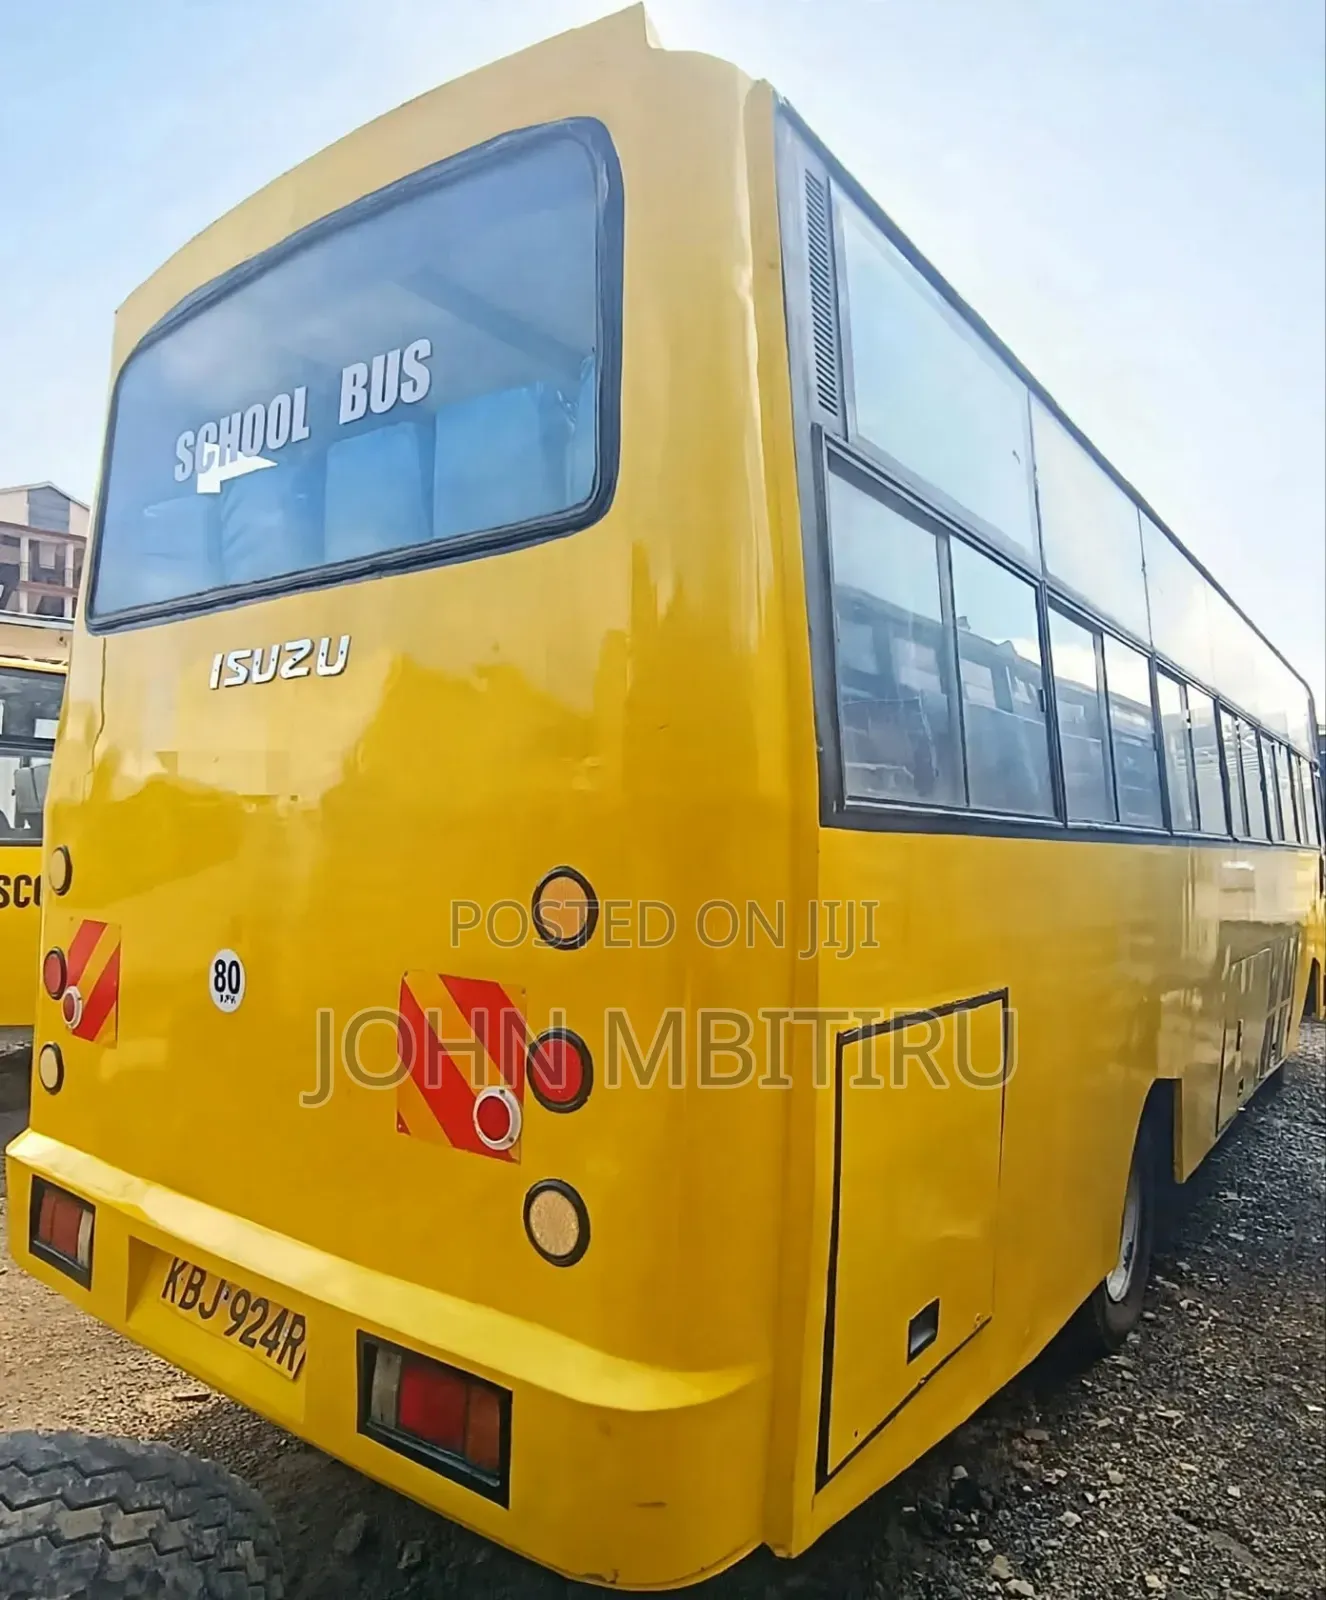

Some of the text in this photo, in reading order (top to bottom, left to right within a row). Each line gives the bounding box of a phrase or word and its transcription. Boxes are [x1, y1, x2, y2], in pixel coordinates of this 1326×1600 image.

[174, 339, 432, 482] SCHOOL BUS
[209, 635, 351, 690] ISUZU
[214, 959, 241, 994] 80
[161, 1256, 306, 1371] KBJ 924R
